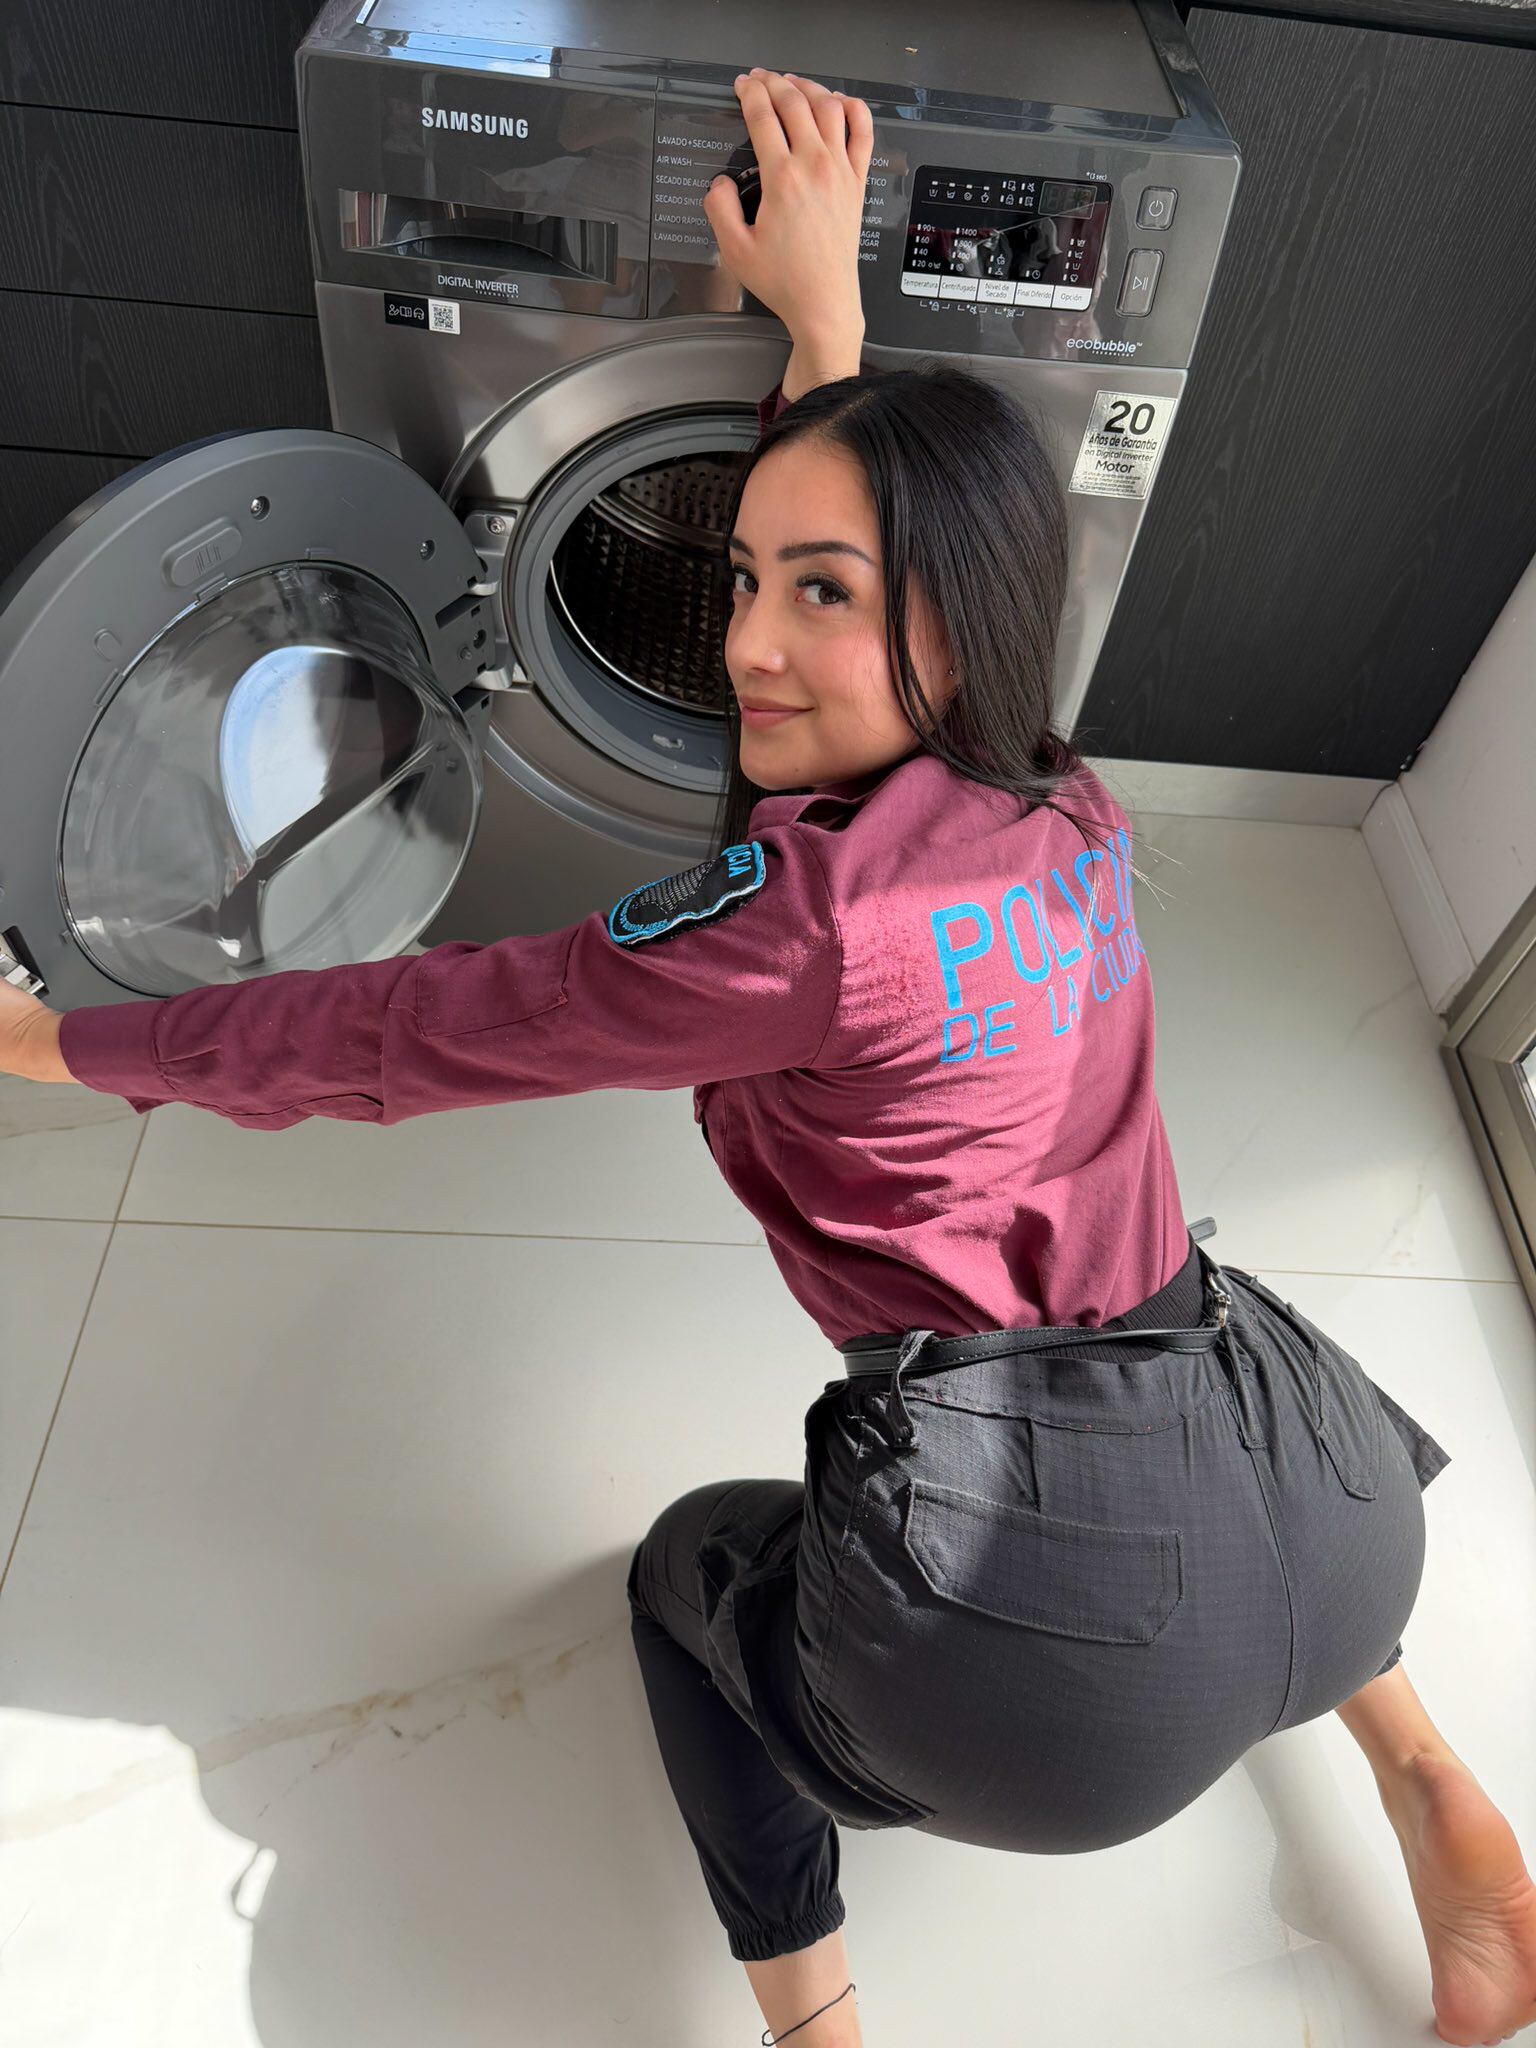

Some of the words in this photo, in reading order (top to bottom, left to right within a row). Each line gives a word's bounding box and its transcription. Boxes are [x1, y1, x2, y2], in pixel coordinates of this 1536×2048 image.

[421, 107, 529, 139] SAMSUNG
[656, 155, 670, 165] AIR
[670, 157, 692, 167] WASH
[655, 175, 682, 186] SECADO
[682, 177, 692, 187] DE
[655, 194, 682, 205] SECADO
[654, 214, 681, 224] LAVADO
[653, 233, 683, 243] LAVADO
[683, 235, 709, 245] DIARIO
[961, 229, 978, 237] 1400
[920, 236, 930, 244] 60
[918, 248, 929, 256] 40
[957, 251, 971, 260] 400
[917, 260, 926, 268] 20
[437, 274, 474, 289] DIGITAL
[475, 279, 519, 294] INVERTER
[904, 278, 939, 290] Temperatura
[941, 281, 976, 293] Centrifugado
[985, 282, 1000, 291] Nivel
[985, 291, 1007, 299] Secado
[1017, 288, 1030, 296] Final
[1031, 290, 1052, 300] Diferido
[1060, 292, 1083, 302] Opción
[1103, 400, 1156, 436] 20
[1088, 434, 1109, 446] Años
[1109, 435, 1120, 447] de
[1121, 437, 1158, 450] Garantía
[1096, 449, 1122, 460] Digital
[1095, 459, 1135, 474] Motor
[930, 827, 1132, 1011] POLICIA
[939, 1000, 1018, 1063] DE
[1047, 975, 1081, 1036] LA
